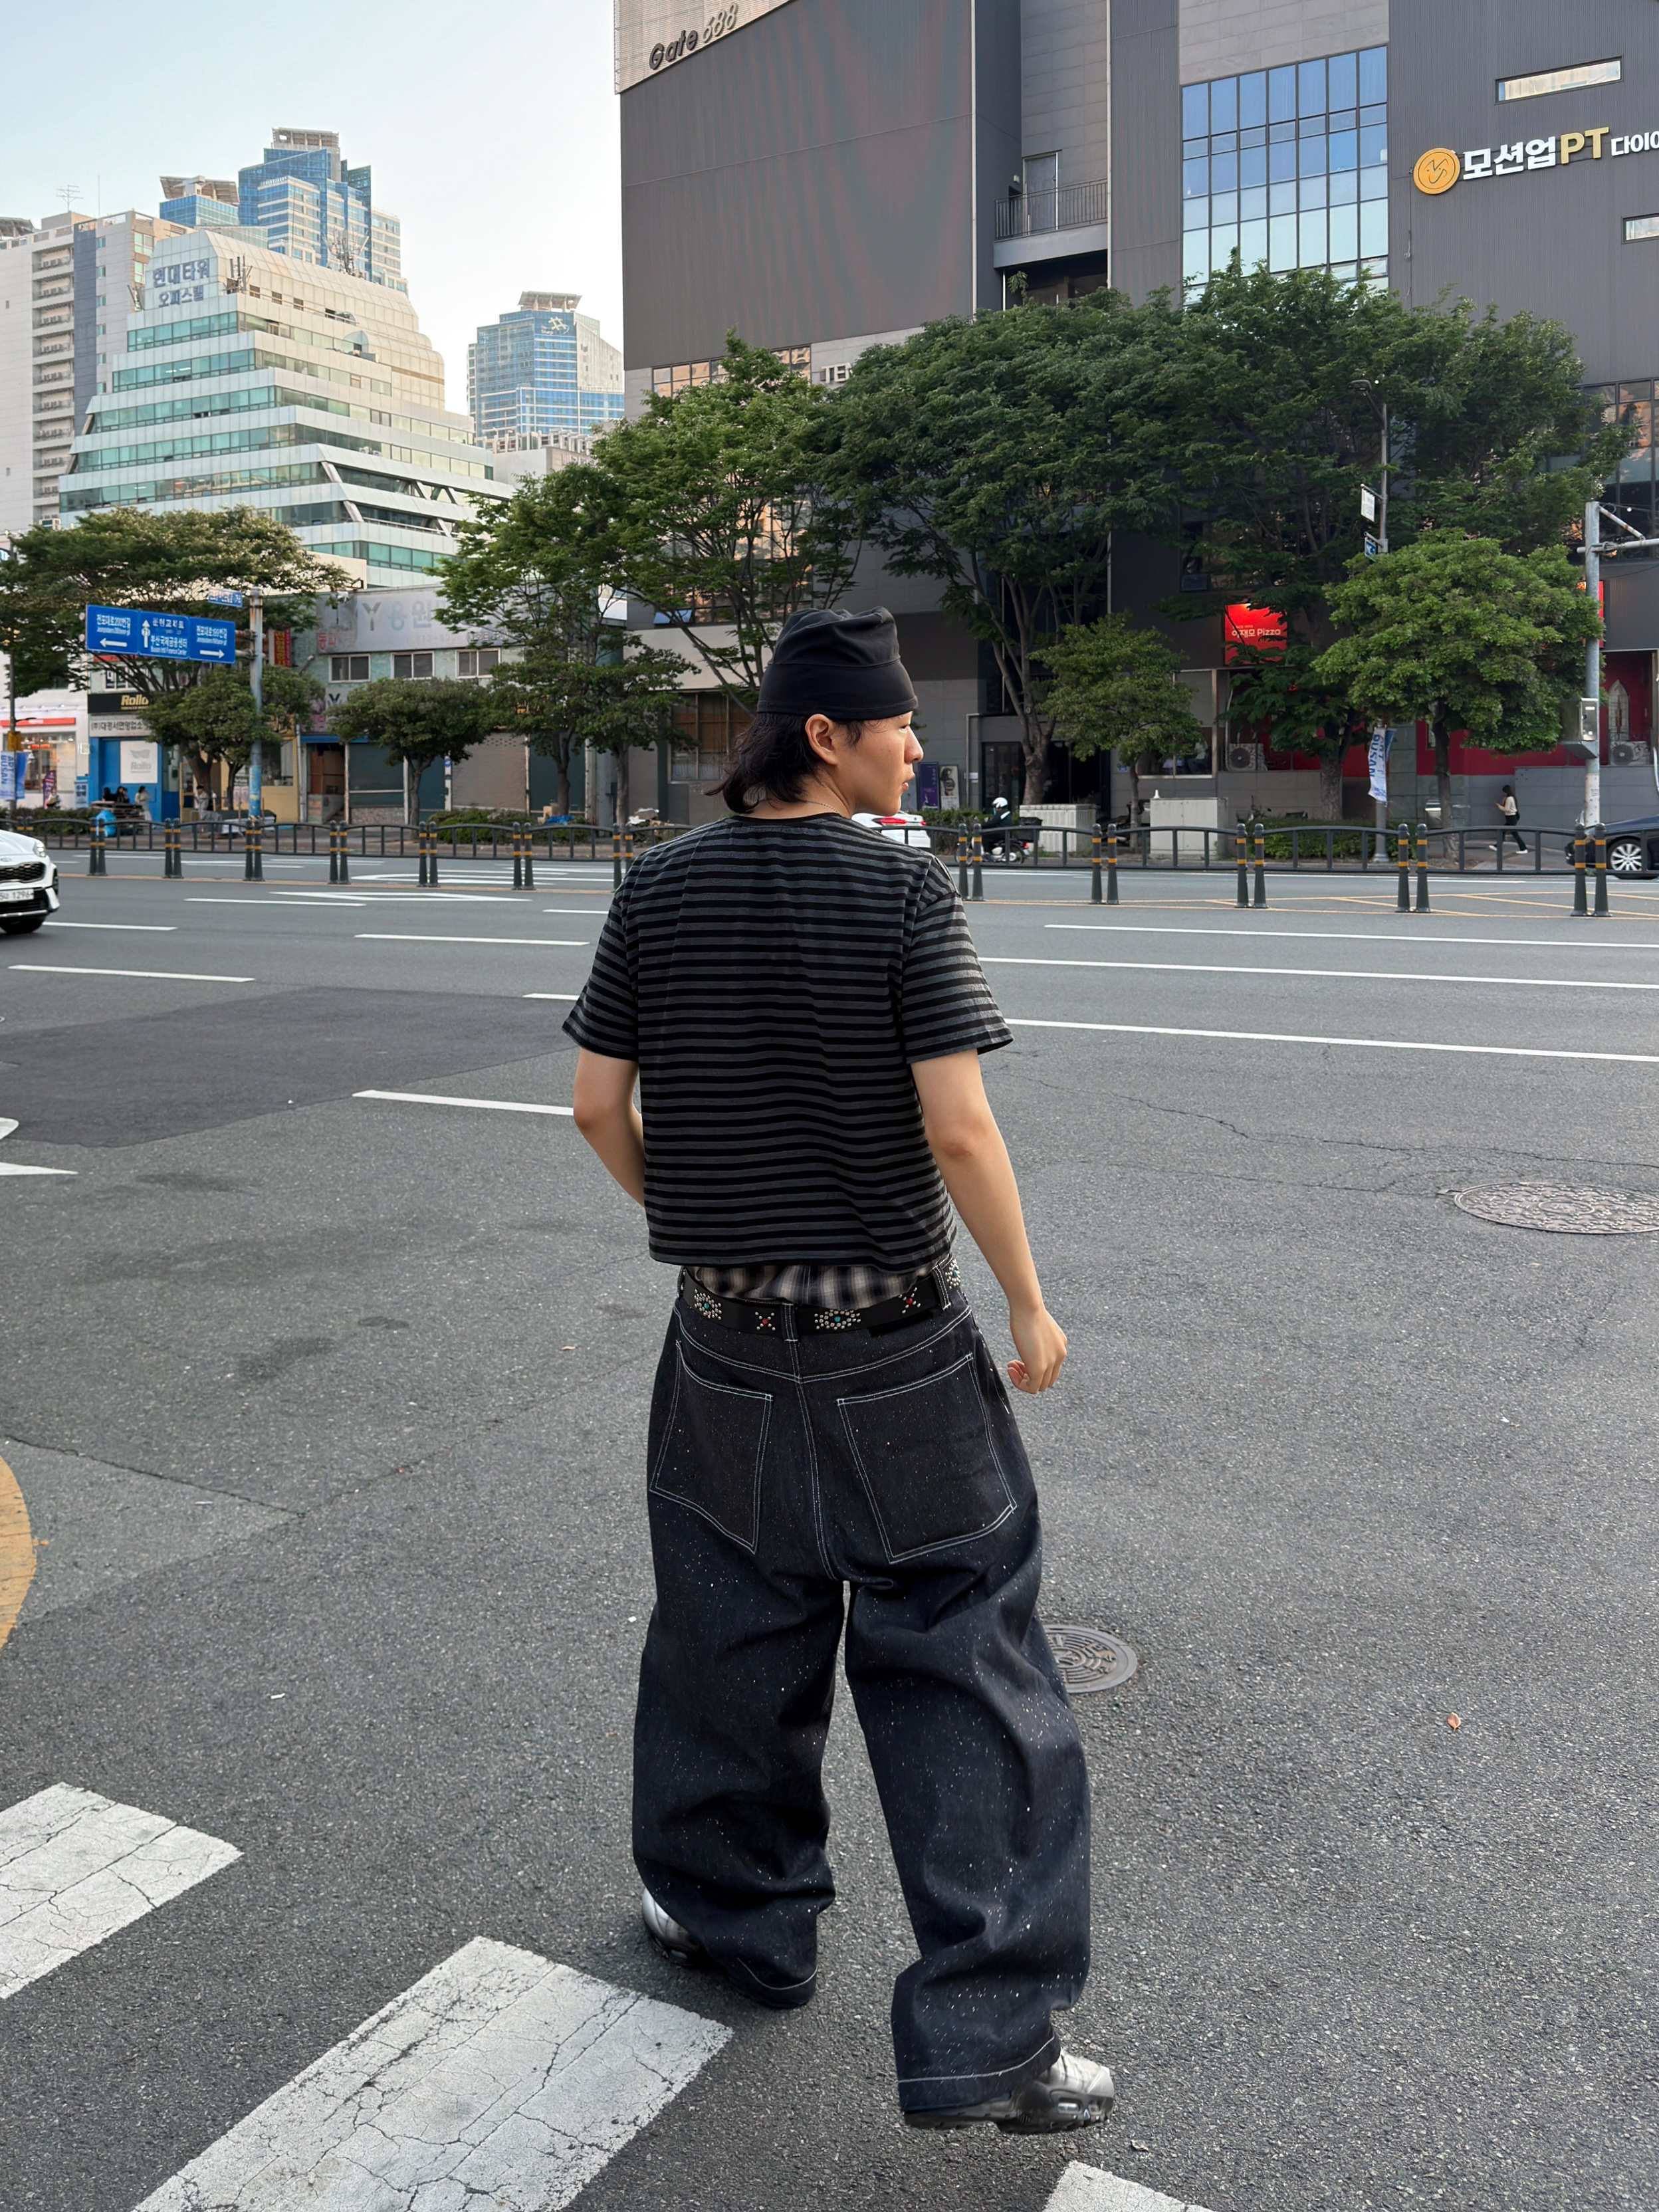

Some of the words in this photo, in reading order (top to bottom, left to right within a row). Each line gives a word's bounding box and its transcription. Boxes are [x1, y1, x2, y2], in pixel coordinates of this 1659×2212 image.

[649, 30, 699, 70] Gate
[702, 3, 738, 43] 688
[153, 258, 210, 288] 현대타워
[120, 695, 149, 706] Rollo
